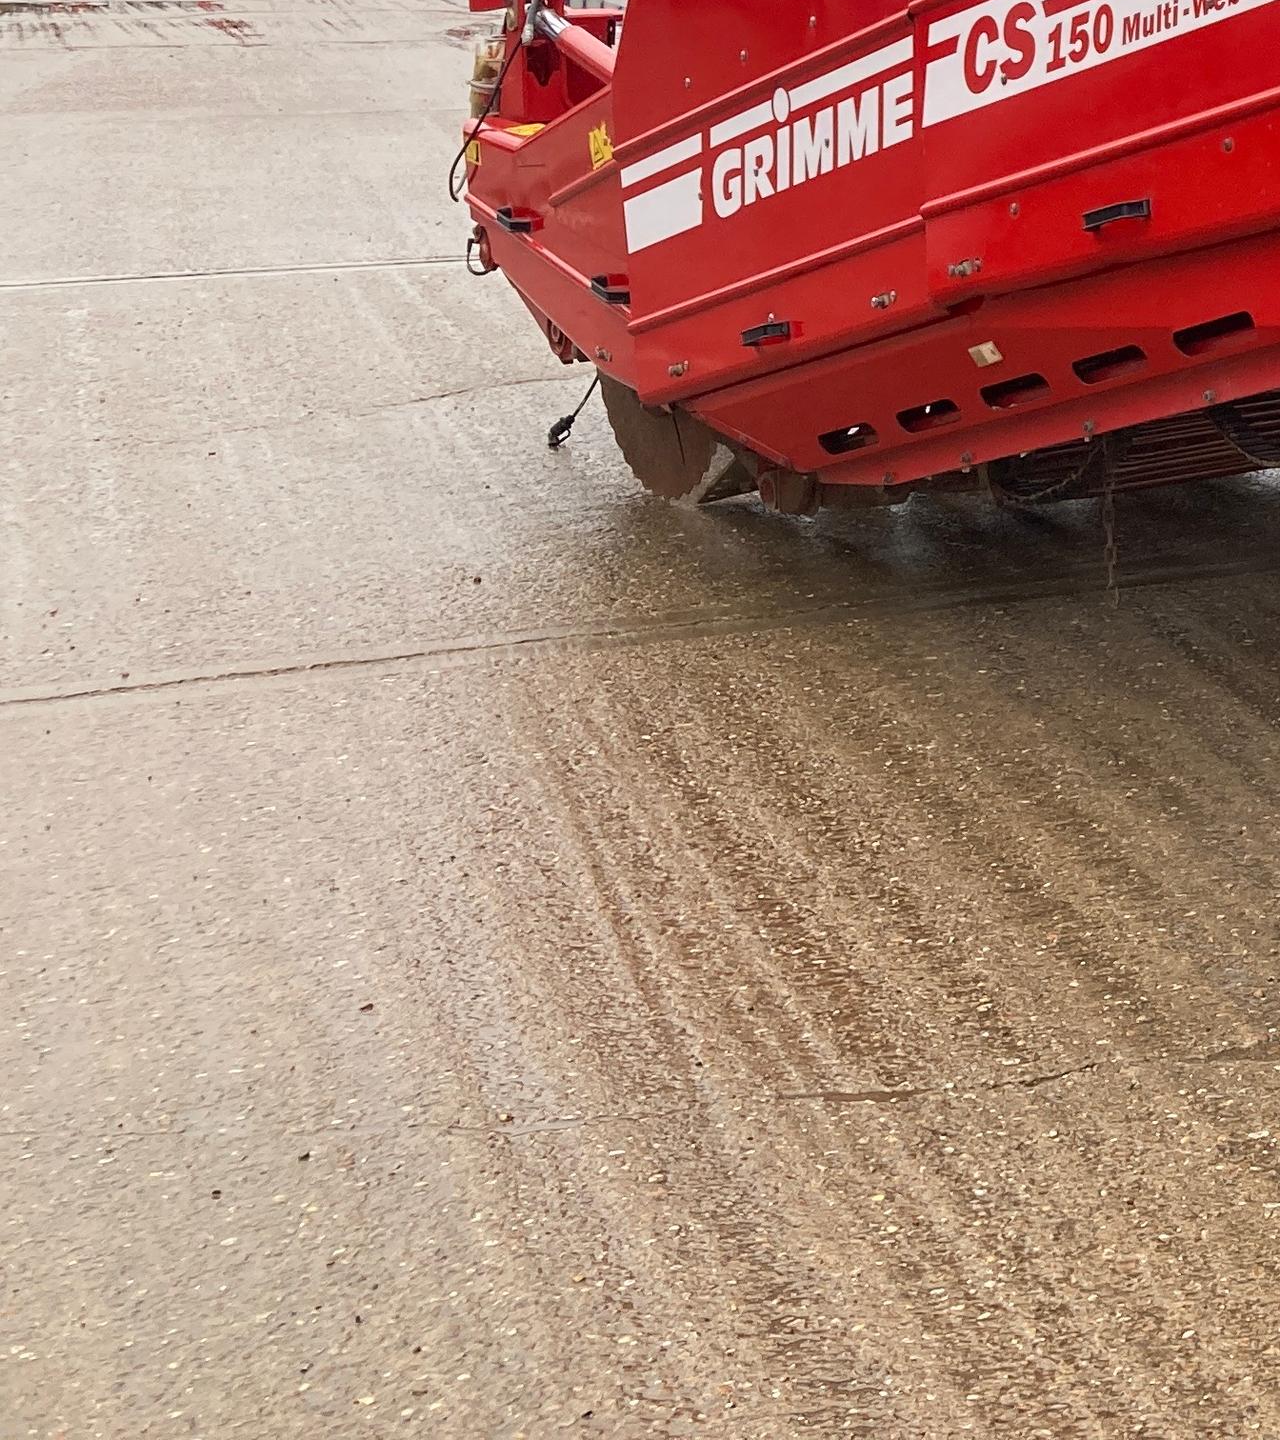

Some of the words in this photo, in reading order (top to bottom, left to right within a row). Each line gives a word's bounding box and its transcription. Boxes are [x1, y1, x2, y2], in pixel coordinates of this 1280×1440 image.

[964, 1, 1036, 95] CS
[1046, 4, 1114, 73] 150
[712, 71, 914, 218] GRIMME
